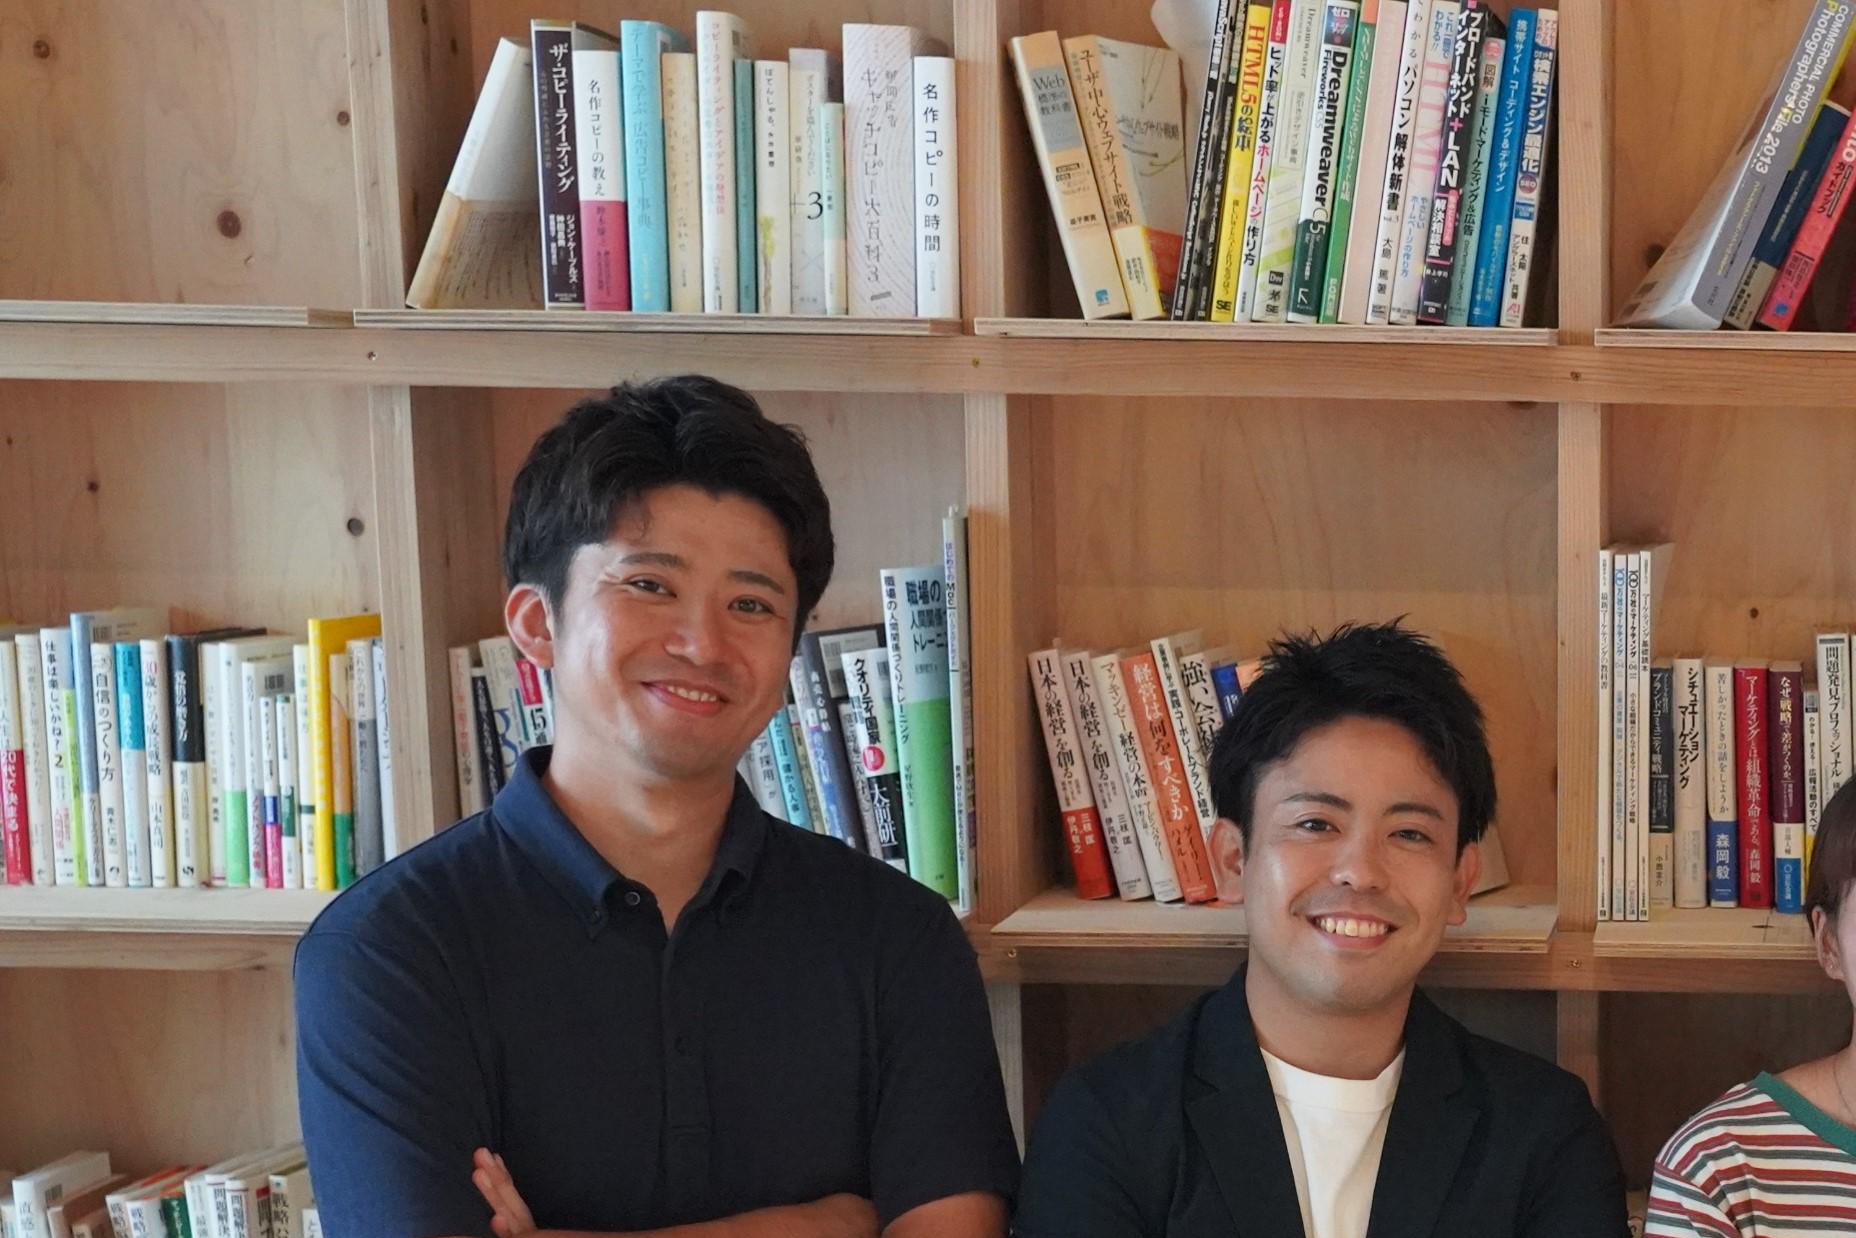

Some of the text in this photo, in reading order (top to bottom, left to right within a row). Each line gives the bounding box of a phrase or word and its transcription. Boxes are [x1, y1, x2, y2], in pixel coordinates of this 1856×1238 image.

[549, 43, 574, 193] ザ・コピーライティング
[1033, 75, 1065, 91] Web
[1235, 24, 1266, 152] HTML5の絵本
[1316, 49, 1333, 110] Fireworks
[1447, 10, 1476, 118] インターネット
[1459, 11, 1485, 118] ブロードバンド
[1792, 4, 1849, 125] COMMERCIAL PHOTO
[589, 80, 606, 196] 名作コピーの教え
[923, 84, 943, 252] 名作コピーの時間
[1079, 50, 1133, 225] ユーザ中心ウェブサイト戦略
[1316, 51, 1348, 208] Dreamweaver
[1754, 136, 1782, 175] 2013
[905, 580, 941, 605] 職場の
[95, 673, 114, 781] 自信のつくり方
[1037, 659, 1075, 780] 日本の経営を創る
[1070, 660, 1111, 781] 日本の経営を創る
[1132, 663, 1189, 821] 経営は何をすべきか
[1678, 705, 1692, 790] マーケティング
[1687, 668, 1700, 764] シチュエーション
[1716, 672, 1730, 815] 苦しかったときの話をしようか
[1825, 646, 1842, 778] 問題発見プロフェッショナル
[1715, 832, 1731, 881] 森岡毅
